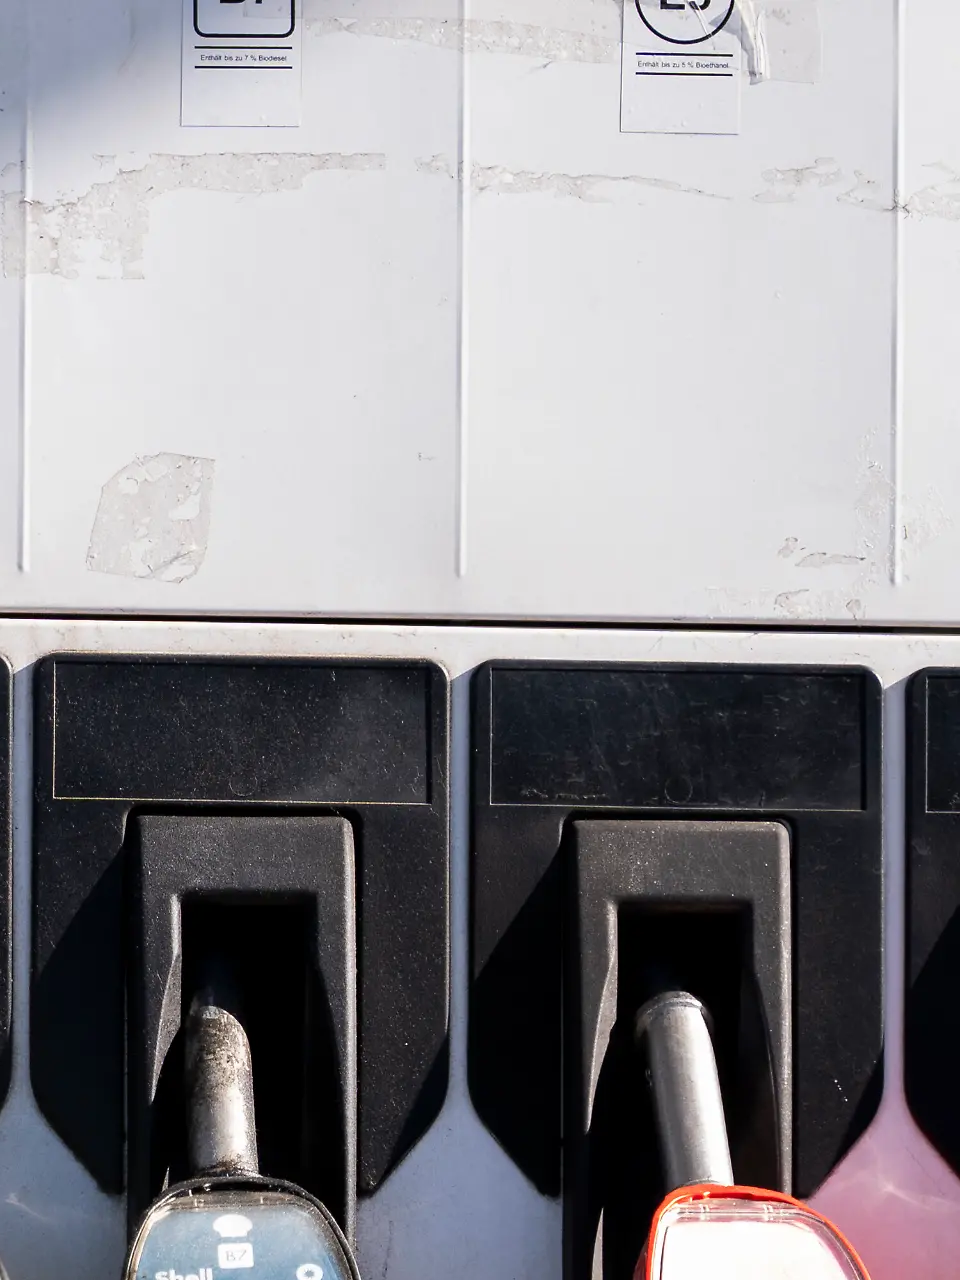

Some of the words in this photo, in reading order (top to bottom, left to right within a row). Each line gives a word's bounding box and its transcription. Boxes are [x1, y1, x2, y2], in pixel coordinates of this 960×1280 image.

[250, 54, 257, 62] %
[258, 54, 287, 62] Biodiesel
[695, 61, 729, 69] Bioethanol
[225, 1249, 248, 1262] B7
